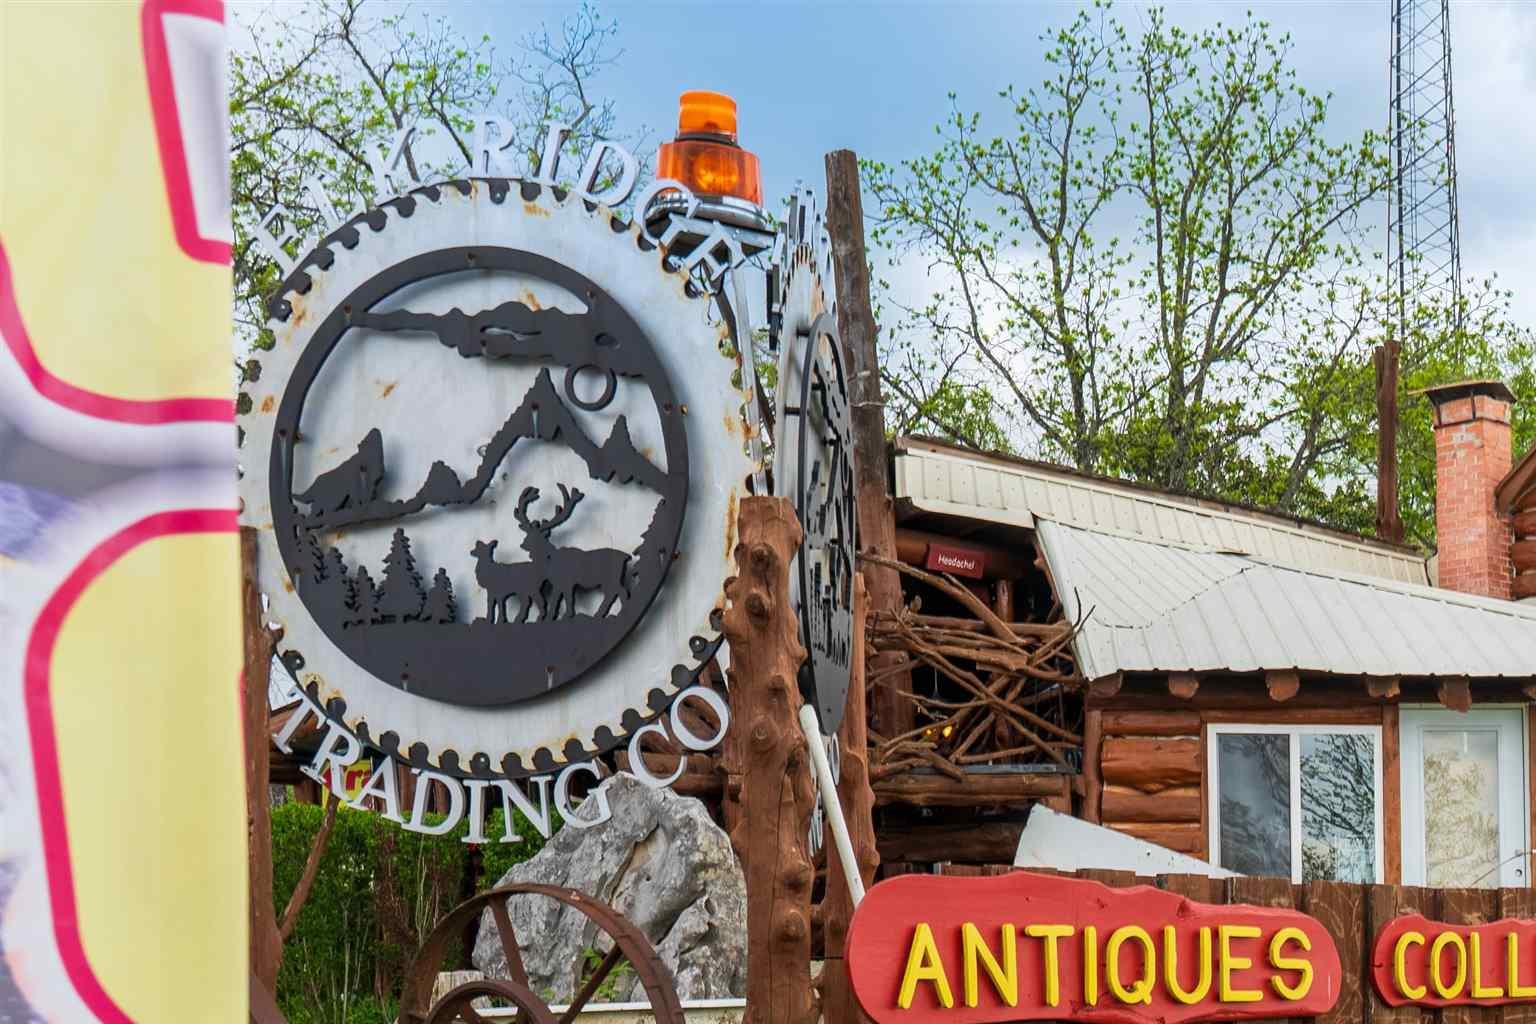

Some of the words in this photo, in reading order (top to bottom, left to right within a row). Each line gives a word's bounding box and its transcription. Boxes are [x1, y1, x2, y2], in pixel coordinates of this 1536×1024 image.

[253, 127, 444, 282] ELK
[467, 113, 747, 281] RIDGE
[271, 684, 614, 844] TRADING
[628, 686, 731, 788] CO
[898, 922, 1313, 1009] ANTIQUES
